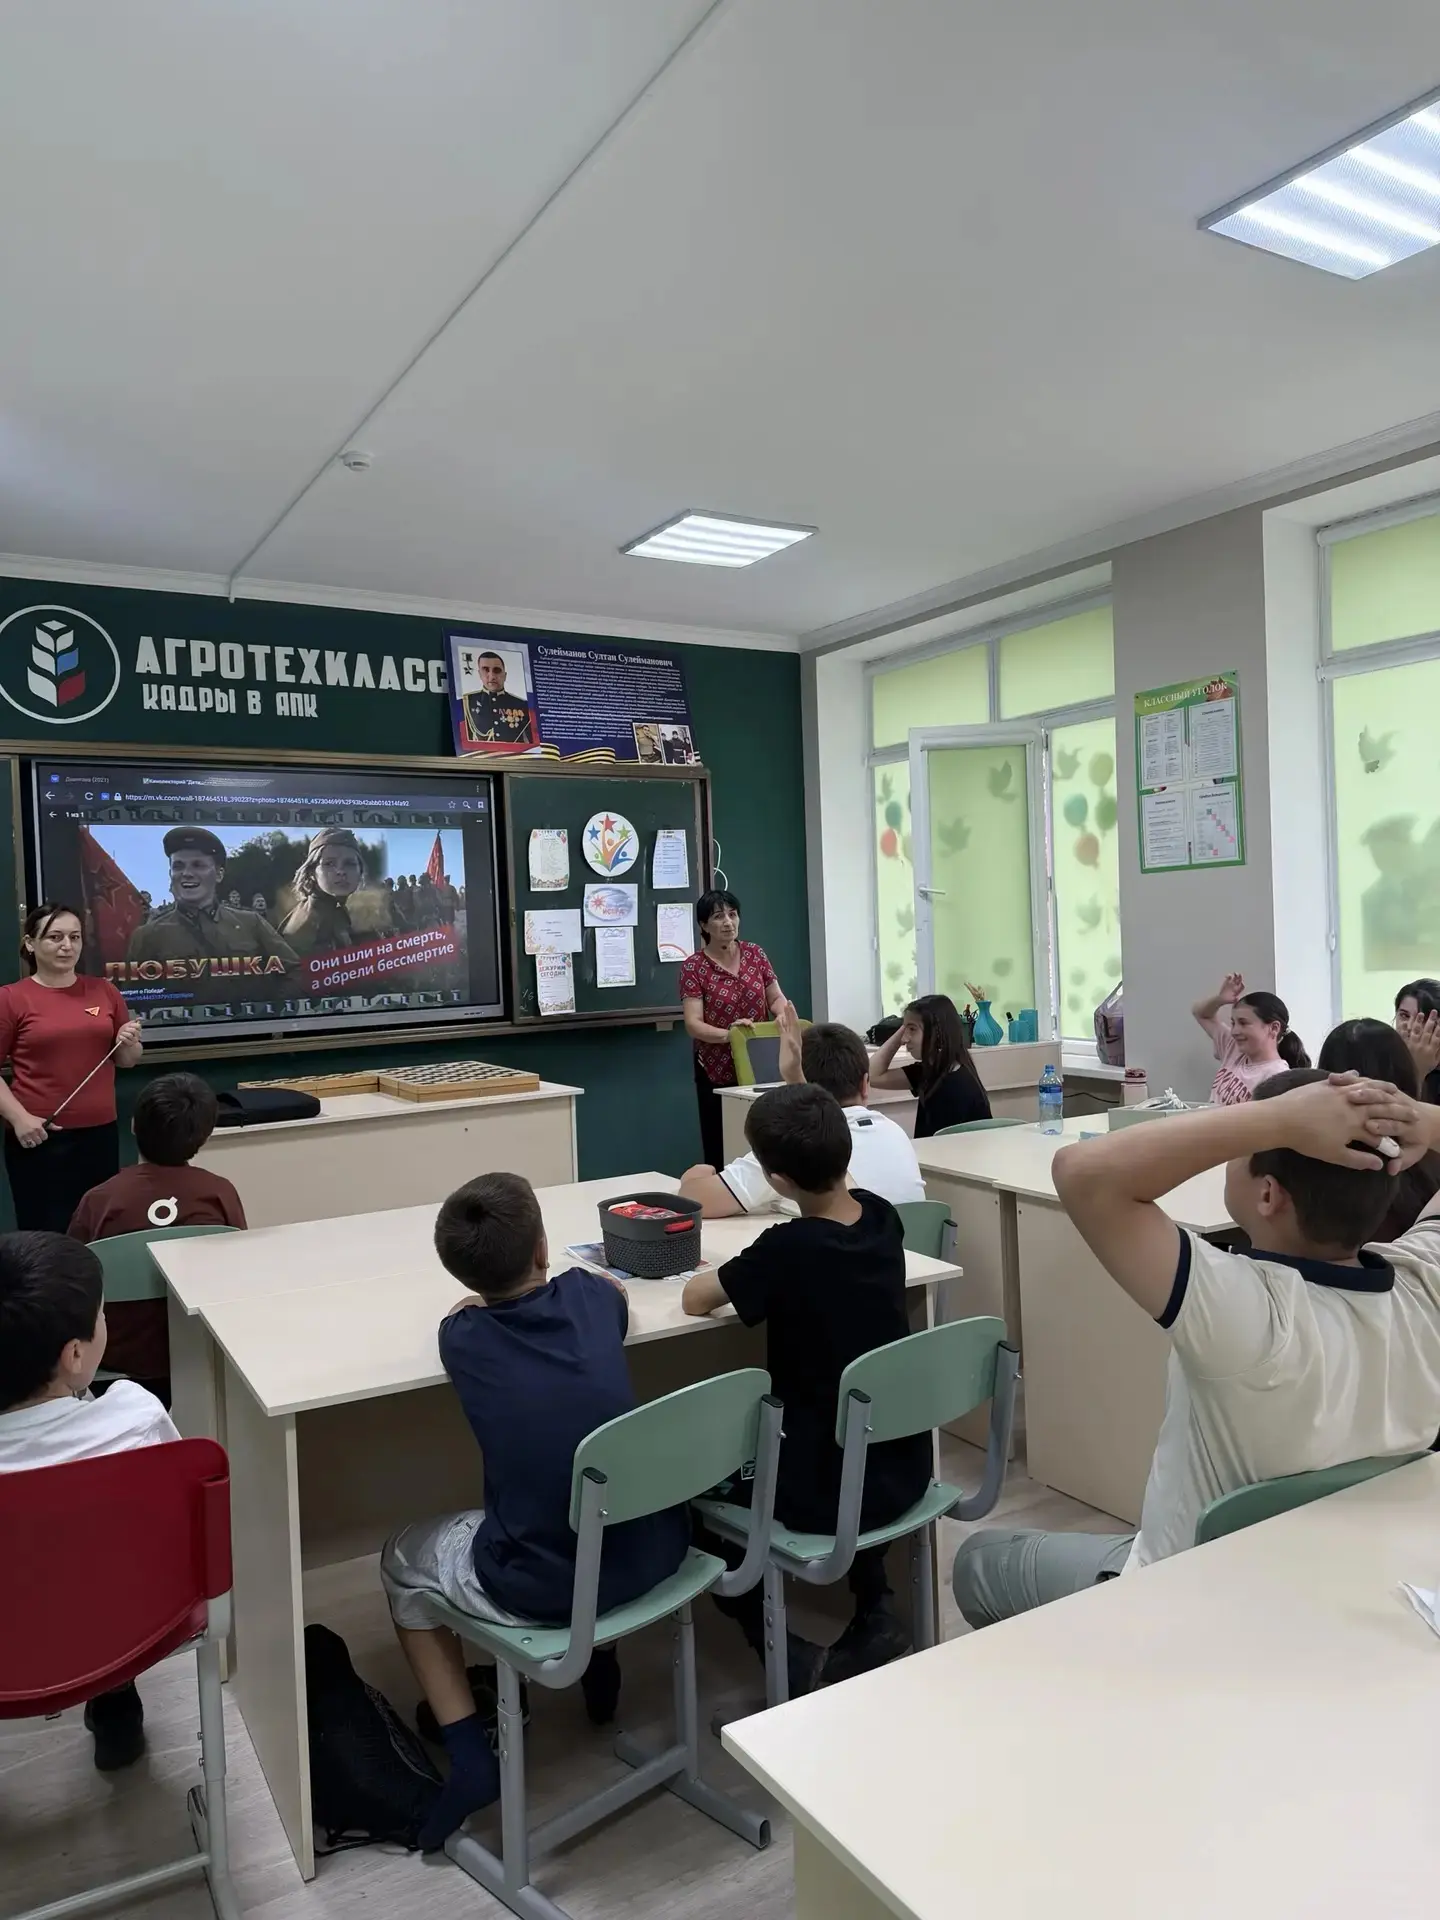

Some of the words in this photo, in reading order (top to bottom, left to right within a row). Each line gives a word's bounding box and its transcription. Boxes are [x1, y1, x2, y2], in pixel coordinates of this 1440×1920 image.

[135, 636, 449, 694] АГРОТЕХКЛАСС
[538, 646, 587, 658] Сулейманов
[588, 651, 617, 661] Султан
[618, 654, 673, 667] Сулейманович
[142, 683, 237, 714] КАДРЫ
[247, 690, 262, 715] В
[276, 692, 318, 718] АПК
[1144, 688, 1191, 707] КЛАССНЫЙ
[1192, 682, 1228, 697] УГОЛОК
[105, 955, 286, 982] ЛЮБУШКА
[309, 956, 340, 973] Они
[343, 947, 374, 965] шли
[376, 942, 393, 956] на
[396, 930, 447, 950] смерть,
[311, 979, 320, 990] а
[323, 964, 374, 987] обрели
[377, 943, 455, 972] бессмертие
